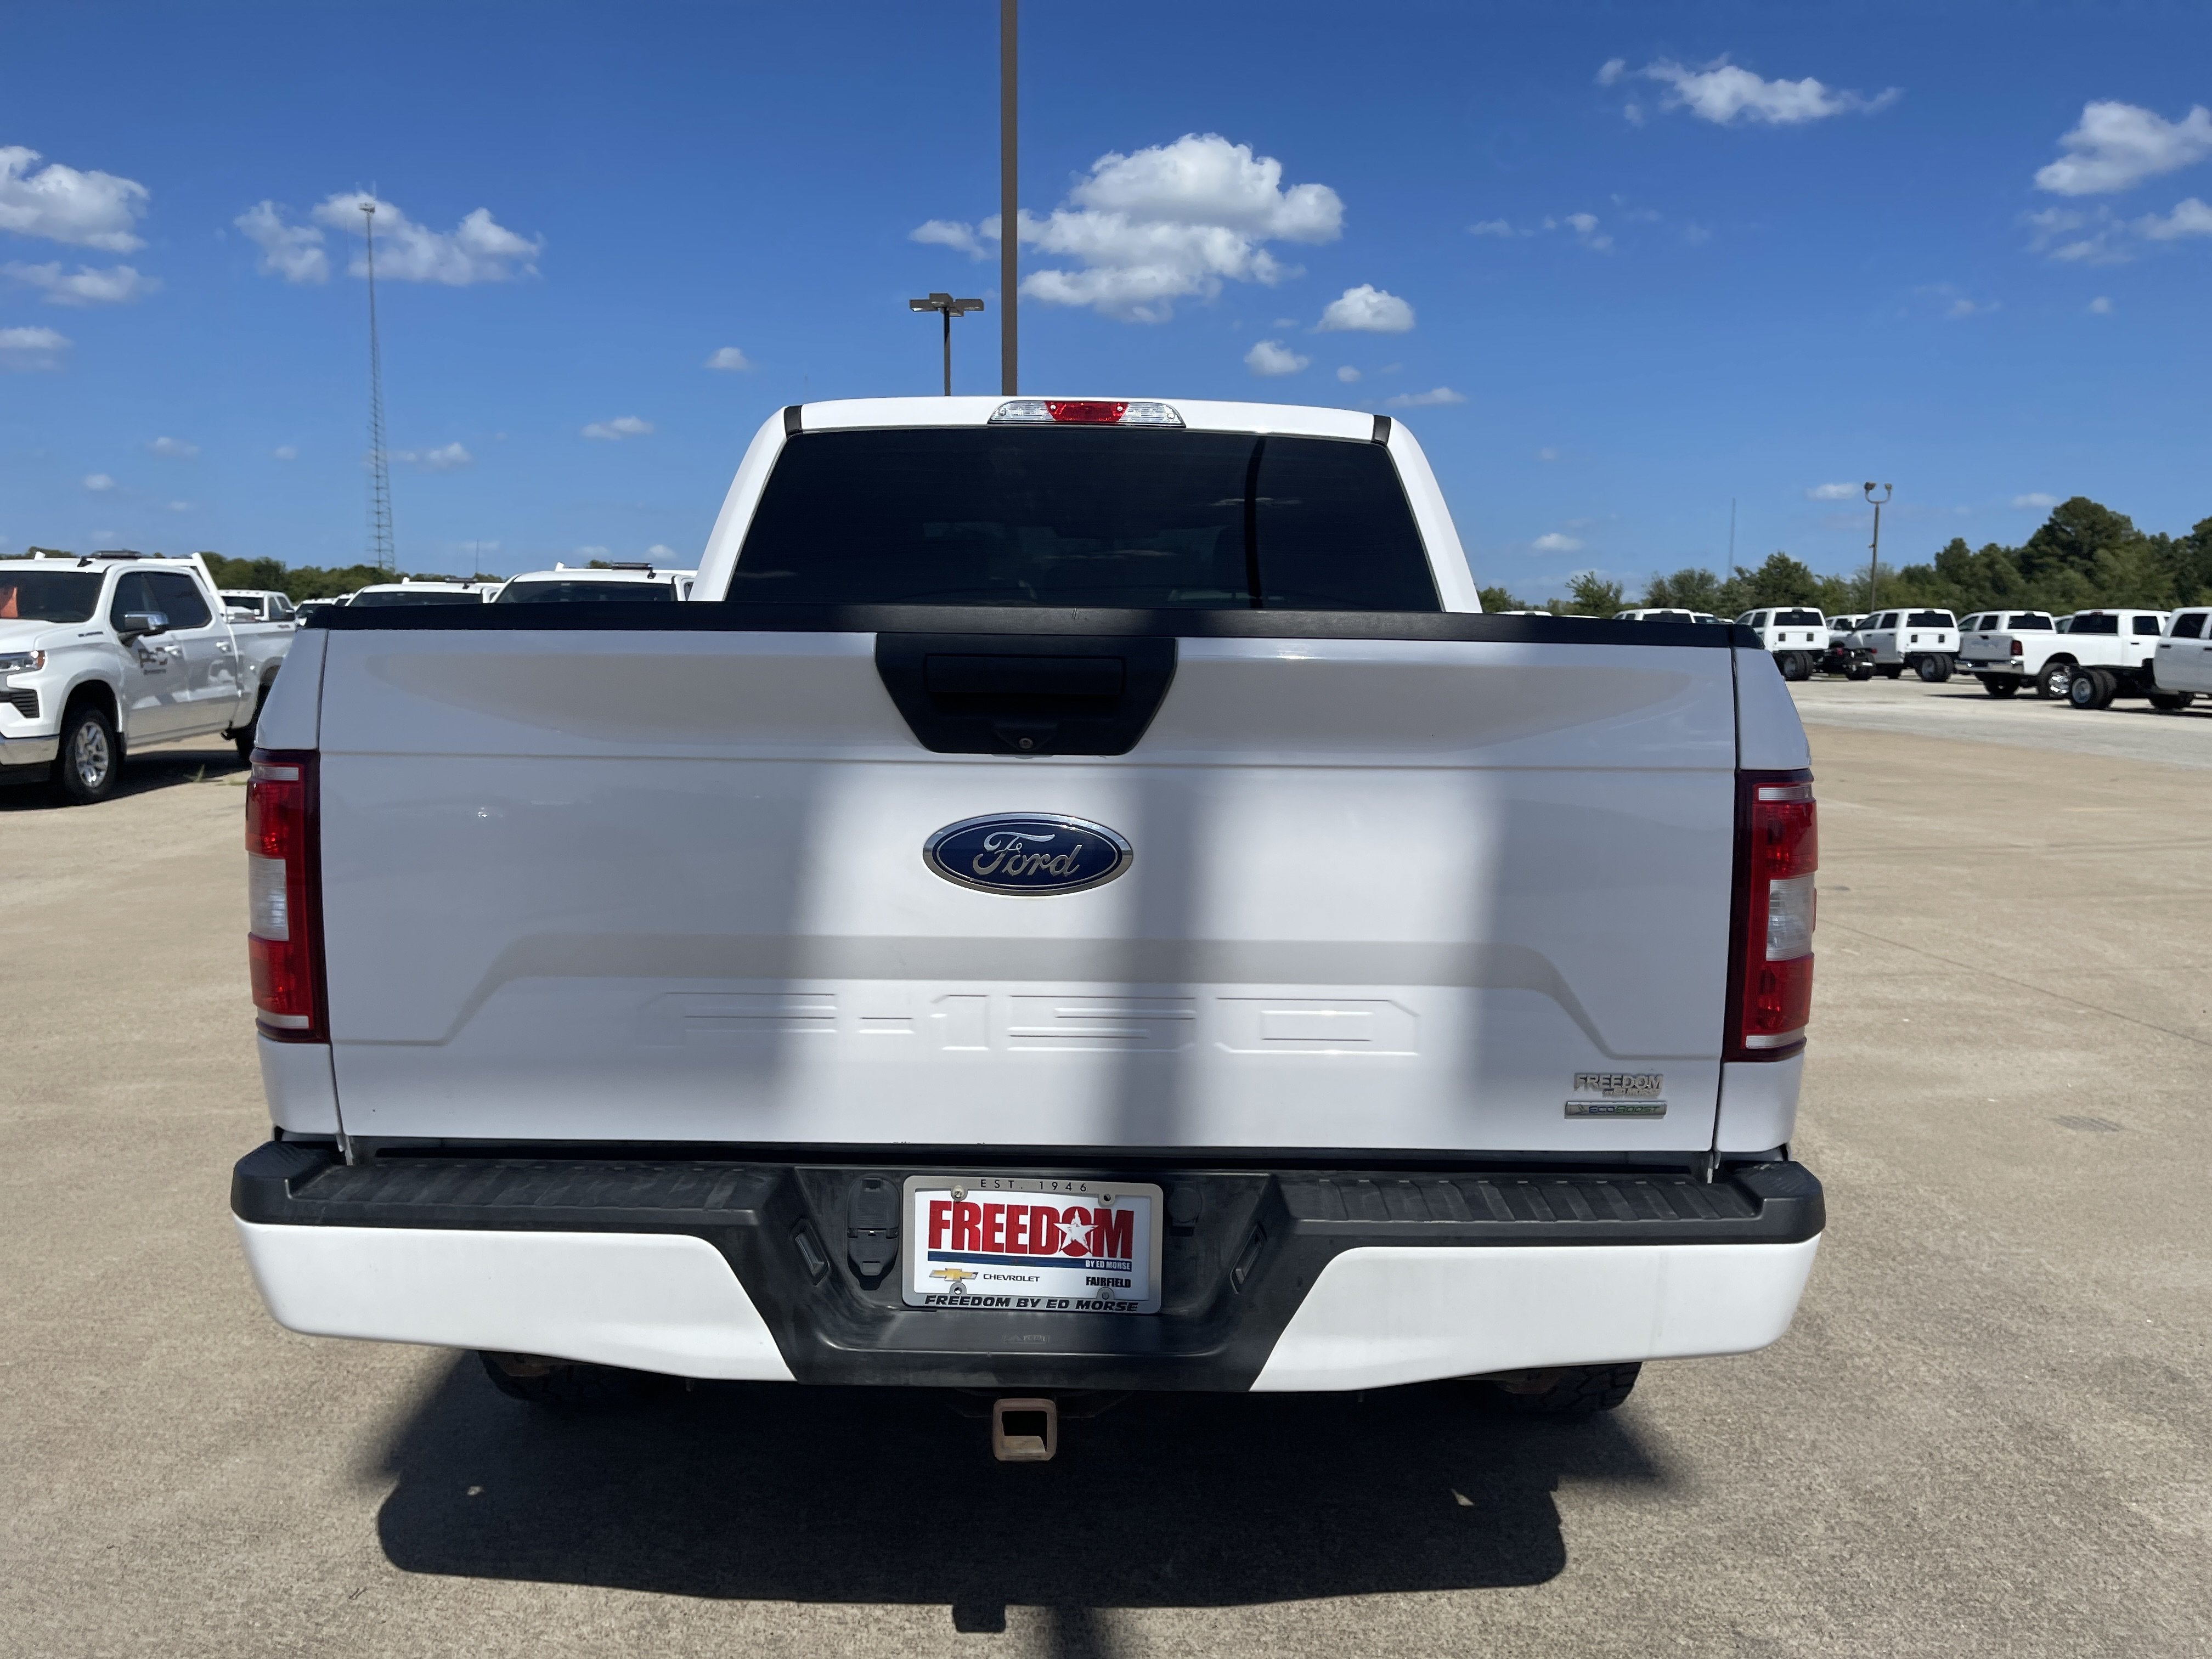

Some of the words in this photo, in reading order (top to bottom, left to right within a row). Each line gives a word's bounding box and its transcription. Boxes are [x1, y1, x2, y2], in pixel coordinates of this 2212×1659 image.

[973, 831, 1082, 877] Ford
[1574, 1074, 1663, 1090] FREEDOM
[980, 1179, 1023, 1189] EST.
[1040, 1181, 1087, 1192] 1946
[929, 1200, 1133, 1258] FREEDOM
[1096, 1260, 1105, 1268] ED
[1107, 1261, 1131, 1270] MORSE
[983, 1274, 1040, 1282] CHEVROLET
[1086, 1276, 1131, 1288] FAIRFIELD
[925, 1295, 1011, 1307] FREEDOM
[1016, 1298, 1042, 1308] BY
[1046, 1299, 1070, 1310] ED
[1075, 1300, 1139, 1312] MORSE
